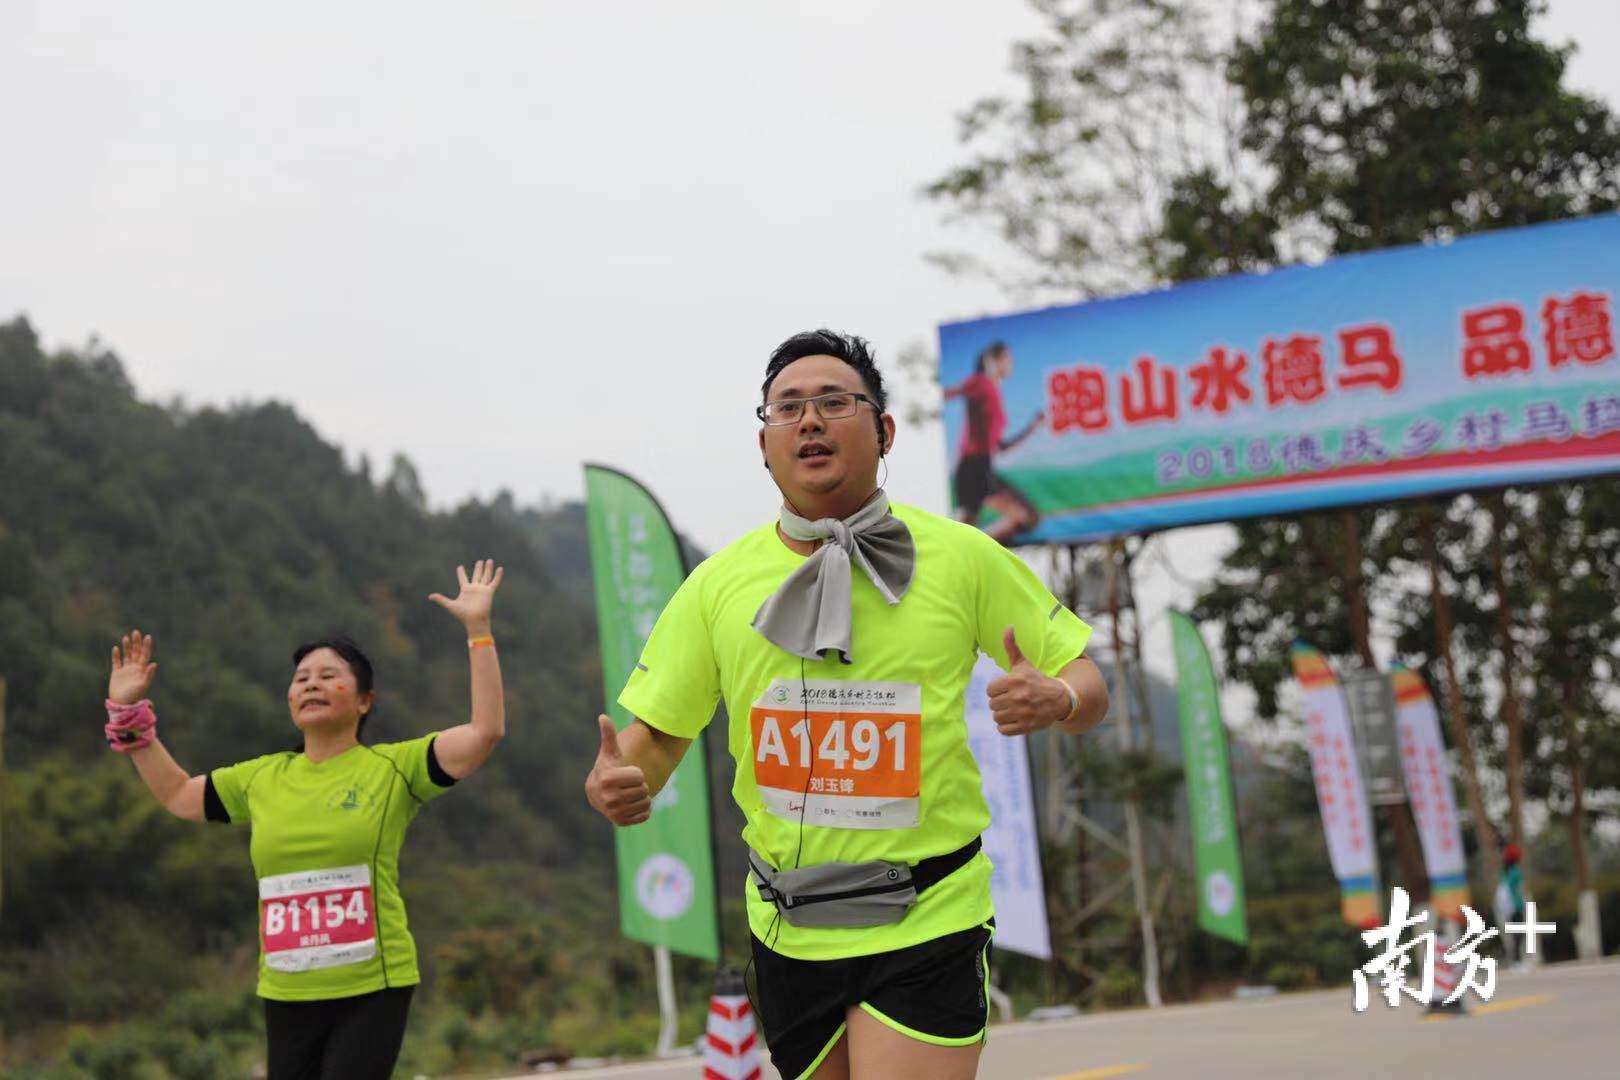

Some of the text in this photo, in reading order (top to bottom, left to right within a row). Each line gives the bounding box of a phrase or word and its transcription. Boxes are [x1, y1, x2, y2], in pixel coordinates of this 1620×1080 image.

[1045, 293, 1614, 434] 跑山水德马 品德
[757, 717, 906, 771] A1491
[266, 891, 368, 936] B1154
